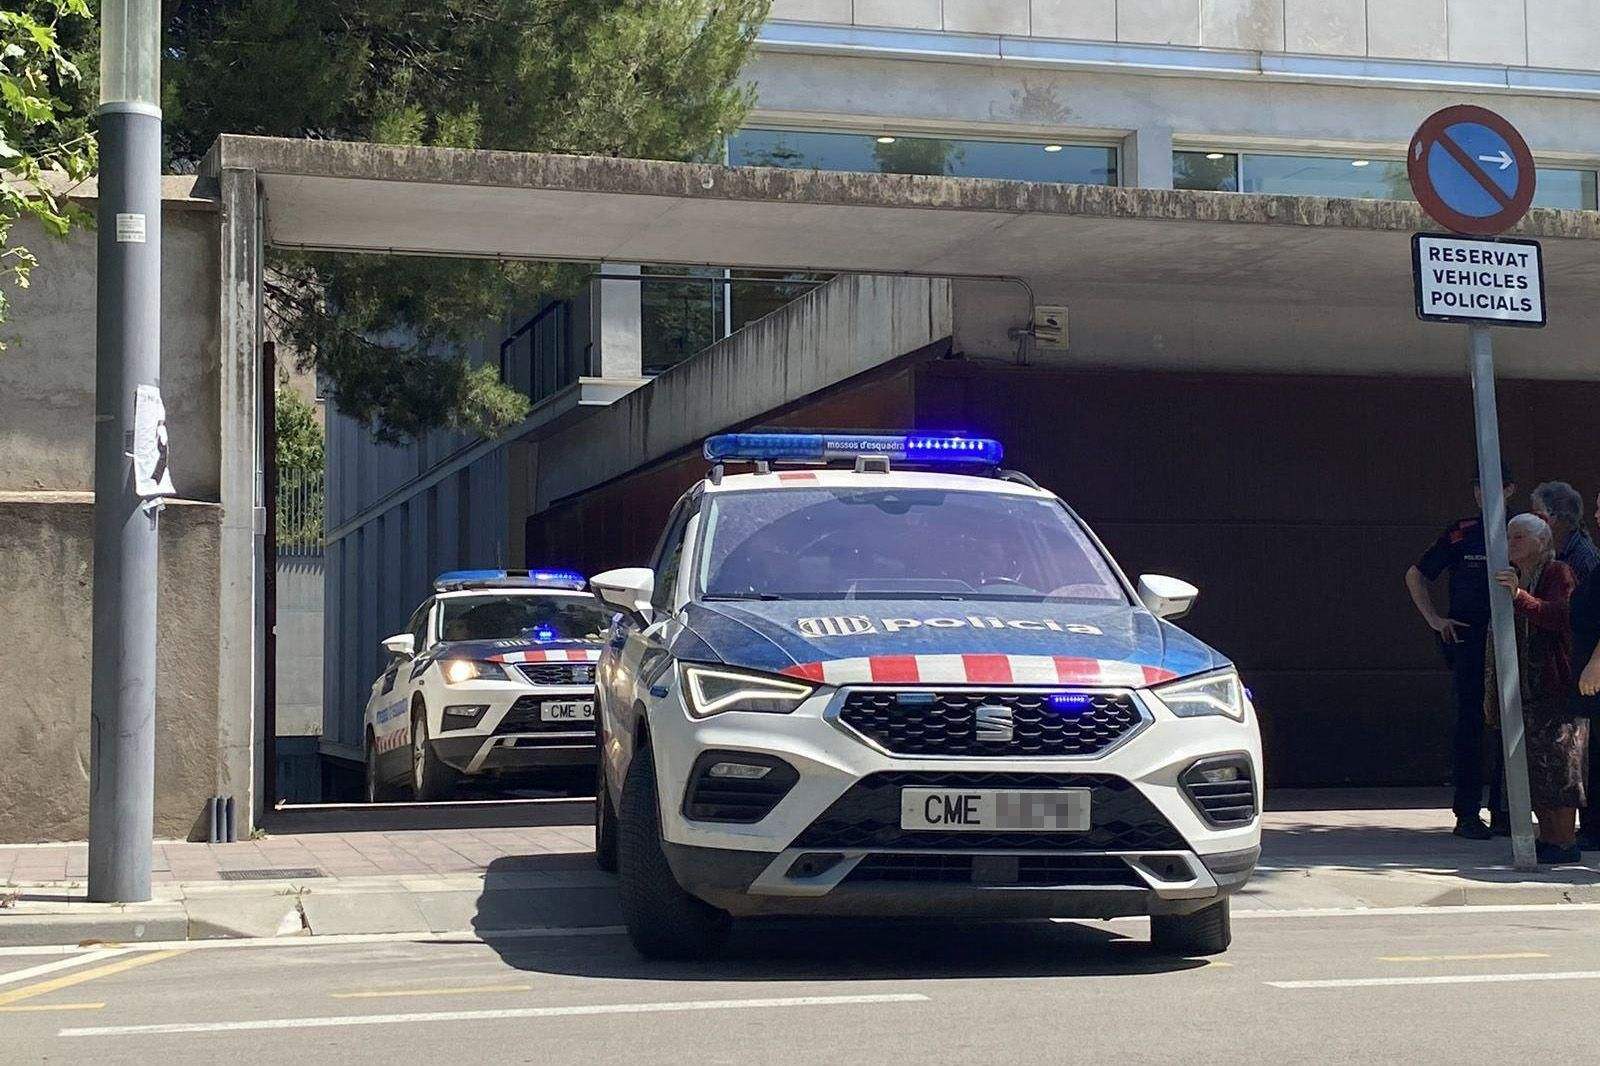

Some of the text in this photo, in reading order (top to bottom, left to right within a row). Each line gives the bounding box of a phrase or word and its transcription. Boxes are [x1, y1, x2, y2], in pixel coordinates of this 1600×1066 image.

[1429, 247, 1528, 267] RESERVAT
[1433, 270, 1528, 289] VEHICLES
[1431, 291, 1532, 312] POLICIALS
[827, 440, 905, 451] mossos d'esquadra
[881, 615, 1103, 634] policia
[551, 704, 576, 718] CME
[924, 794, 981, 825] CME
